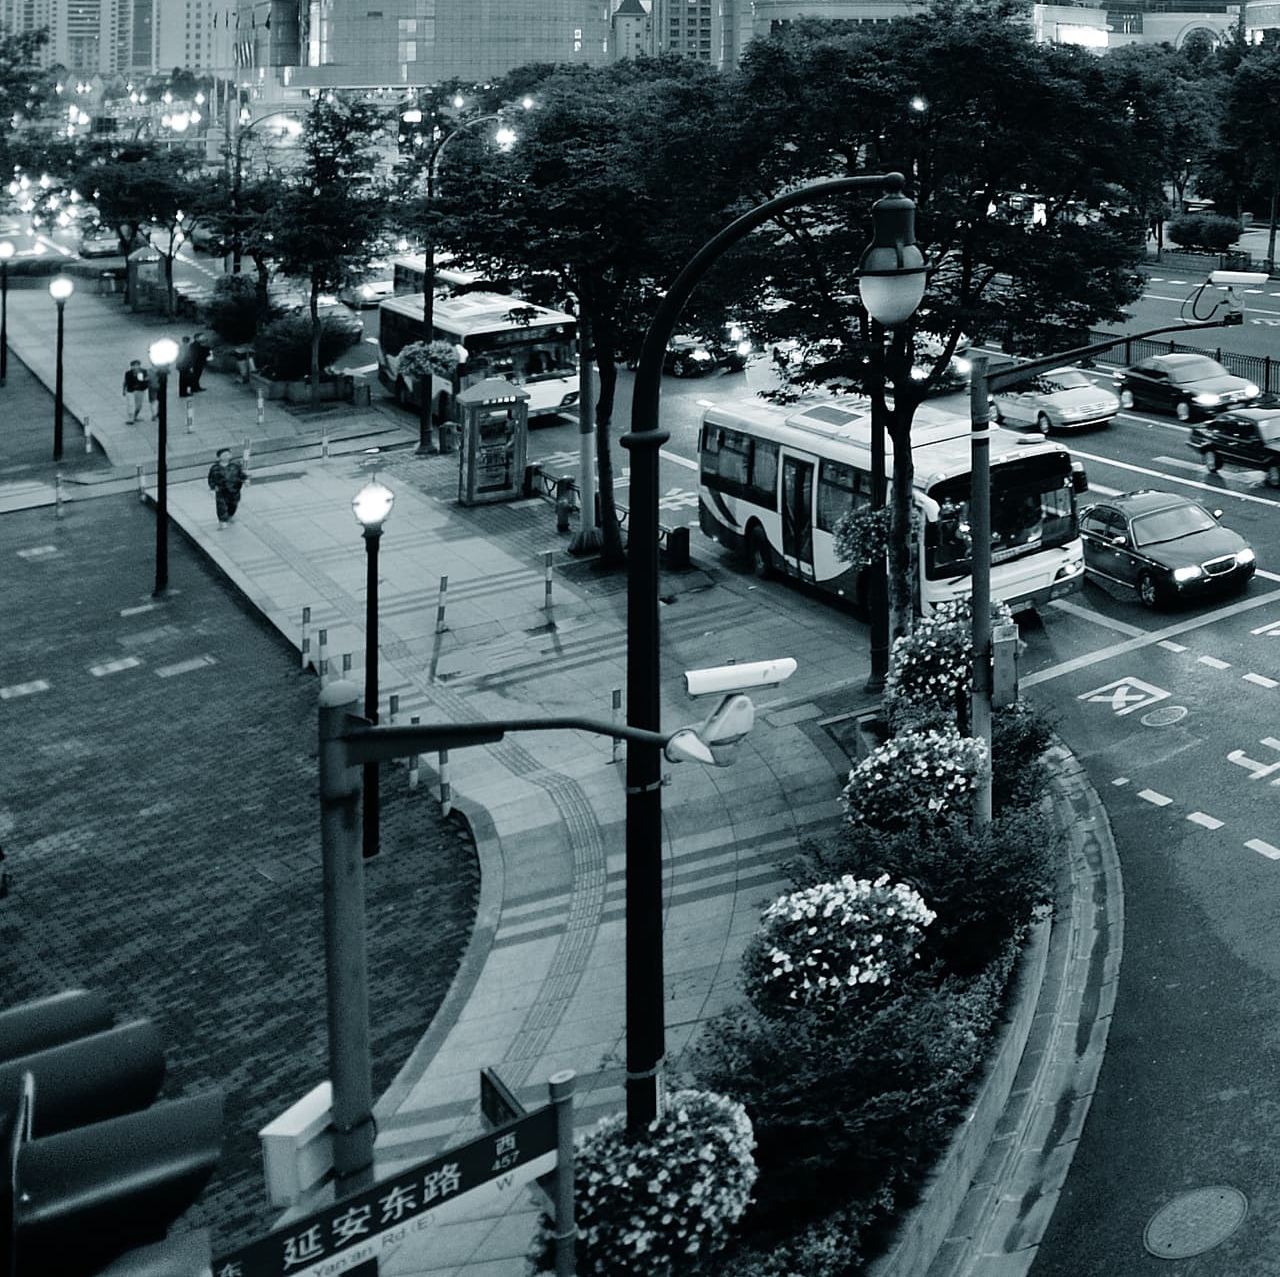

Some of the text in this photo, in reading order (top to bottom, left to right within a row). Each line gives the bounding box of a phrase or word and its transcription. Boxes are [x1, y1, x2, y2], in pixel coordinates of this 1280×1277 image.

[495, 1131, 516, 1156] 西
[496, 1173, 513, 1191] W
[283, 1162, 462, 1270] 延安东路
